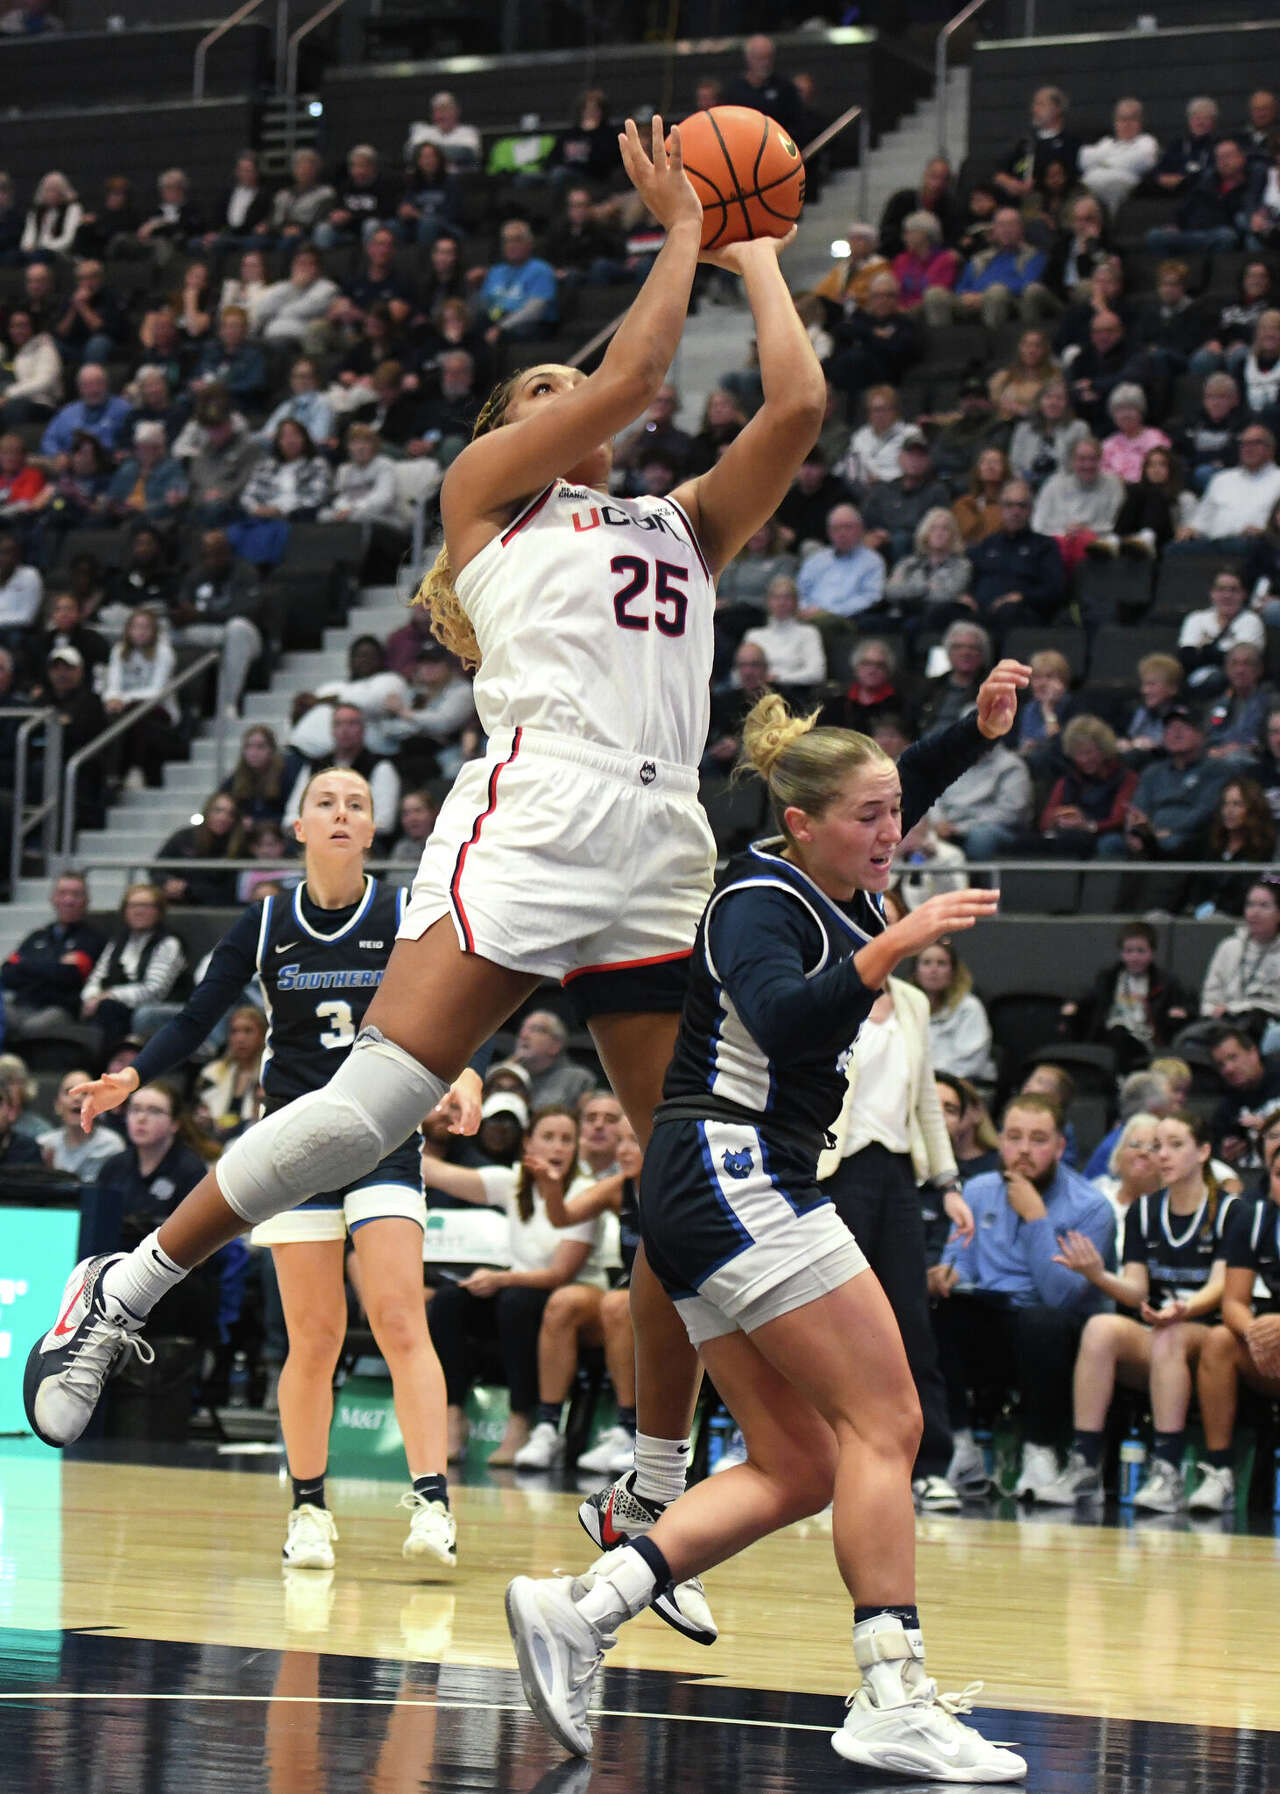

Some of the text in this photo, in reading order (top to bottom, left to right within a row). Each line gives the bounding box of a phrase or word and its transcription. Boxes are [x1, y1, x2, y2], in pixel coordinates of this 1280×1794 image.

[571, 506, 690, 549] UCON
[610, 555, 689, 638] 25
[316, 1000, 355, 1049] 3
